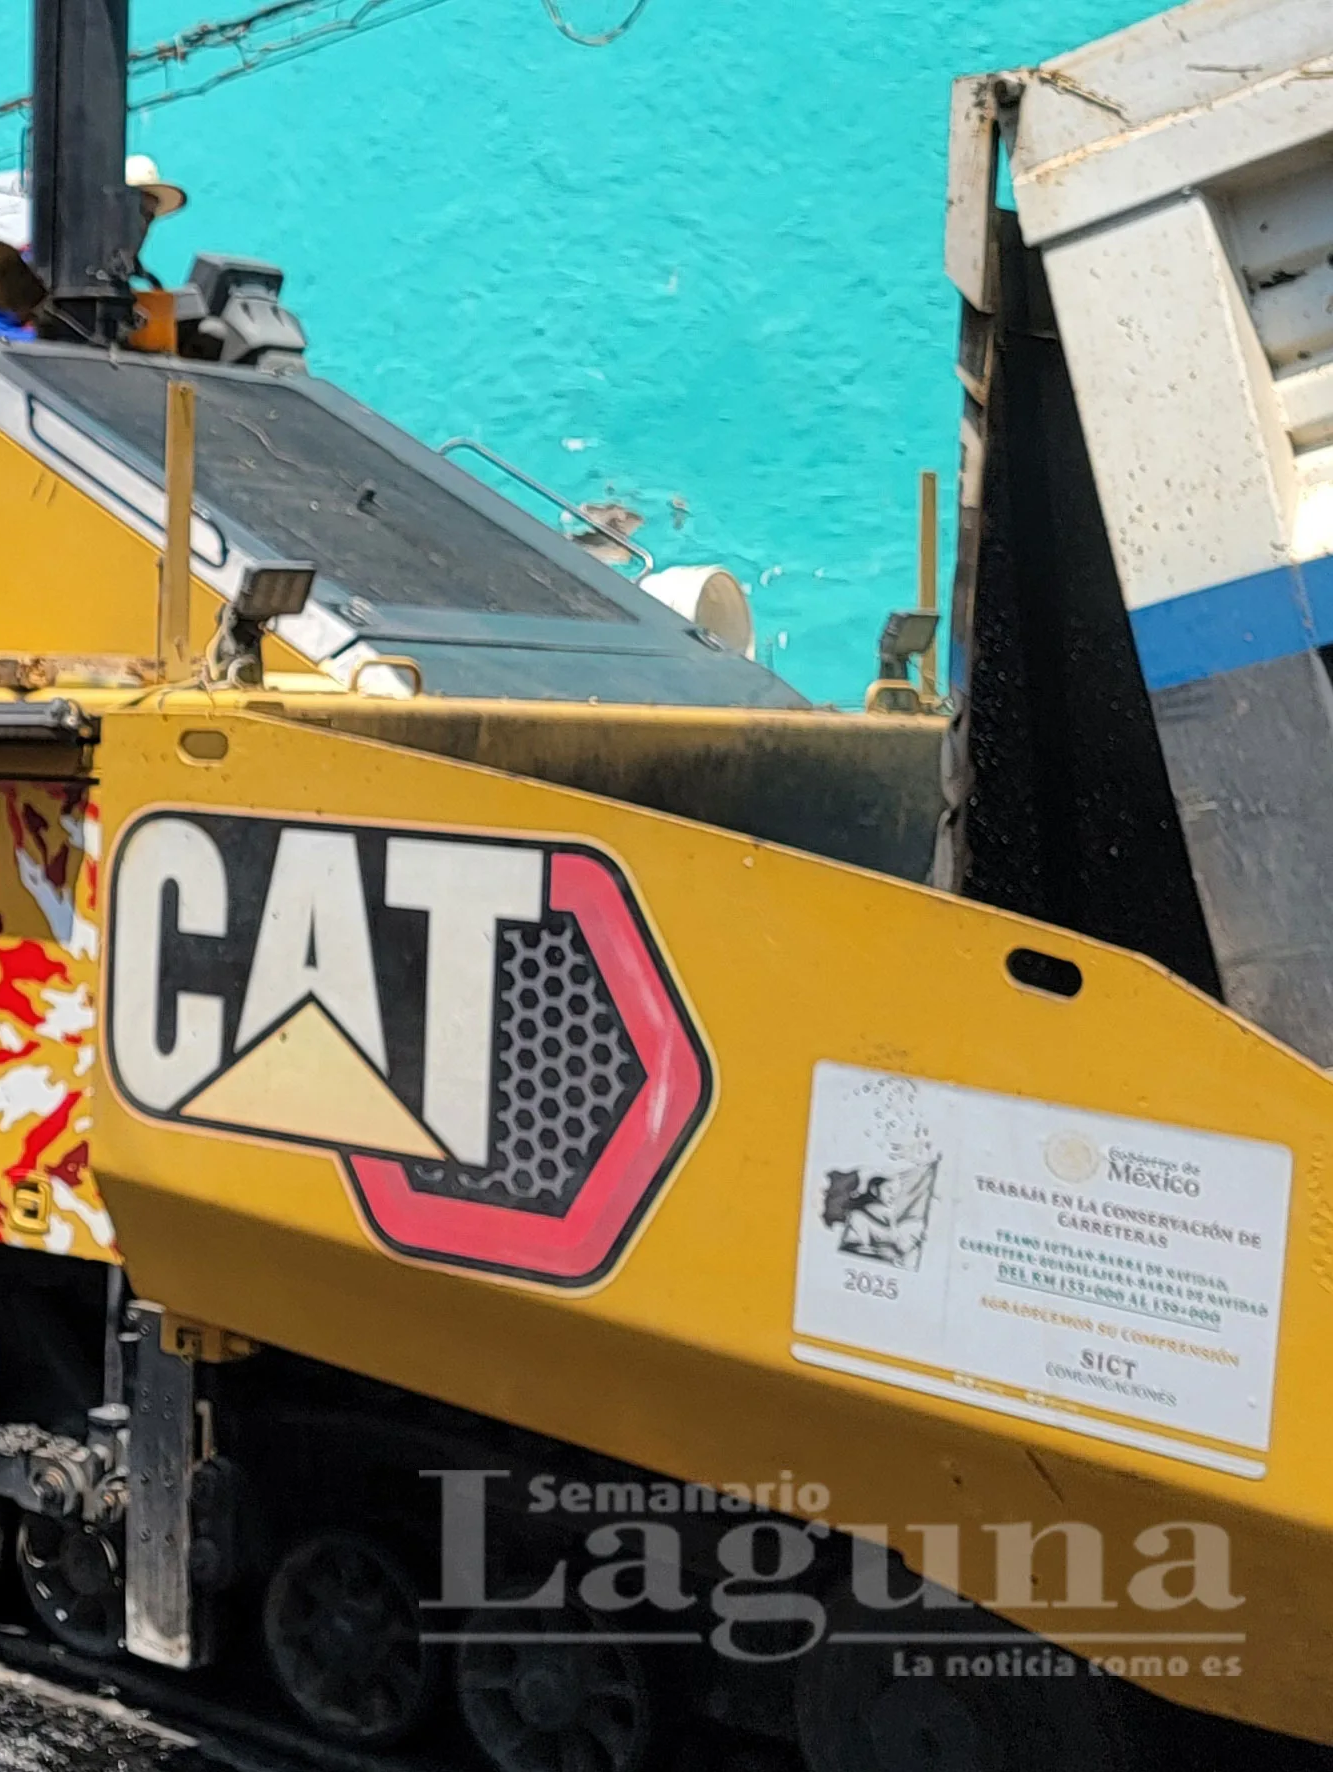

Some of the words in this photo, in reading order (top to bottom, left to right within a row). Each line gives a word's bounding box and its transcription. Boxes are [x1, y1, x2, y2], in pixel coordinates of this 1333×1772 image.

[110, 816, 544, 1167] CAT
[1108, 1161, 1200, 1198] México
[1051, 1191, 1074, 1209] EN
[1077, 1195, 1098, 1215] LA
[1101, 1200, 1234, 1243] CONSERVACIÓN
[1237, 1230, 1262, 1250] DE
[1056, 1210, 1169, 1249] CARRETERAS
[843, 1267, 900, 1300] 2025
[997, 1262, 1028, 1284] DEL
[979, 1294, 1095, 1333] AGRADECEMOS
[1097, 1321, 1118, 1340] SU
[1079, 1347, 1139, 1380] SICT
[1045, 1360, 1178, 1408] COMUNICACIONES
